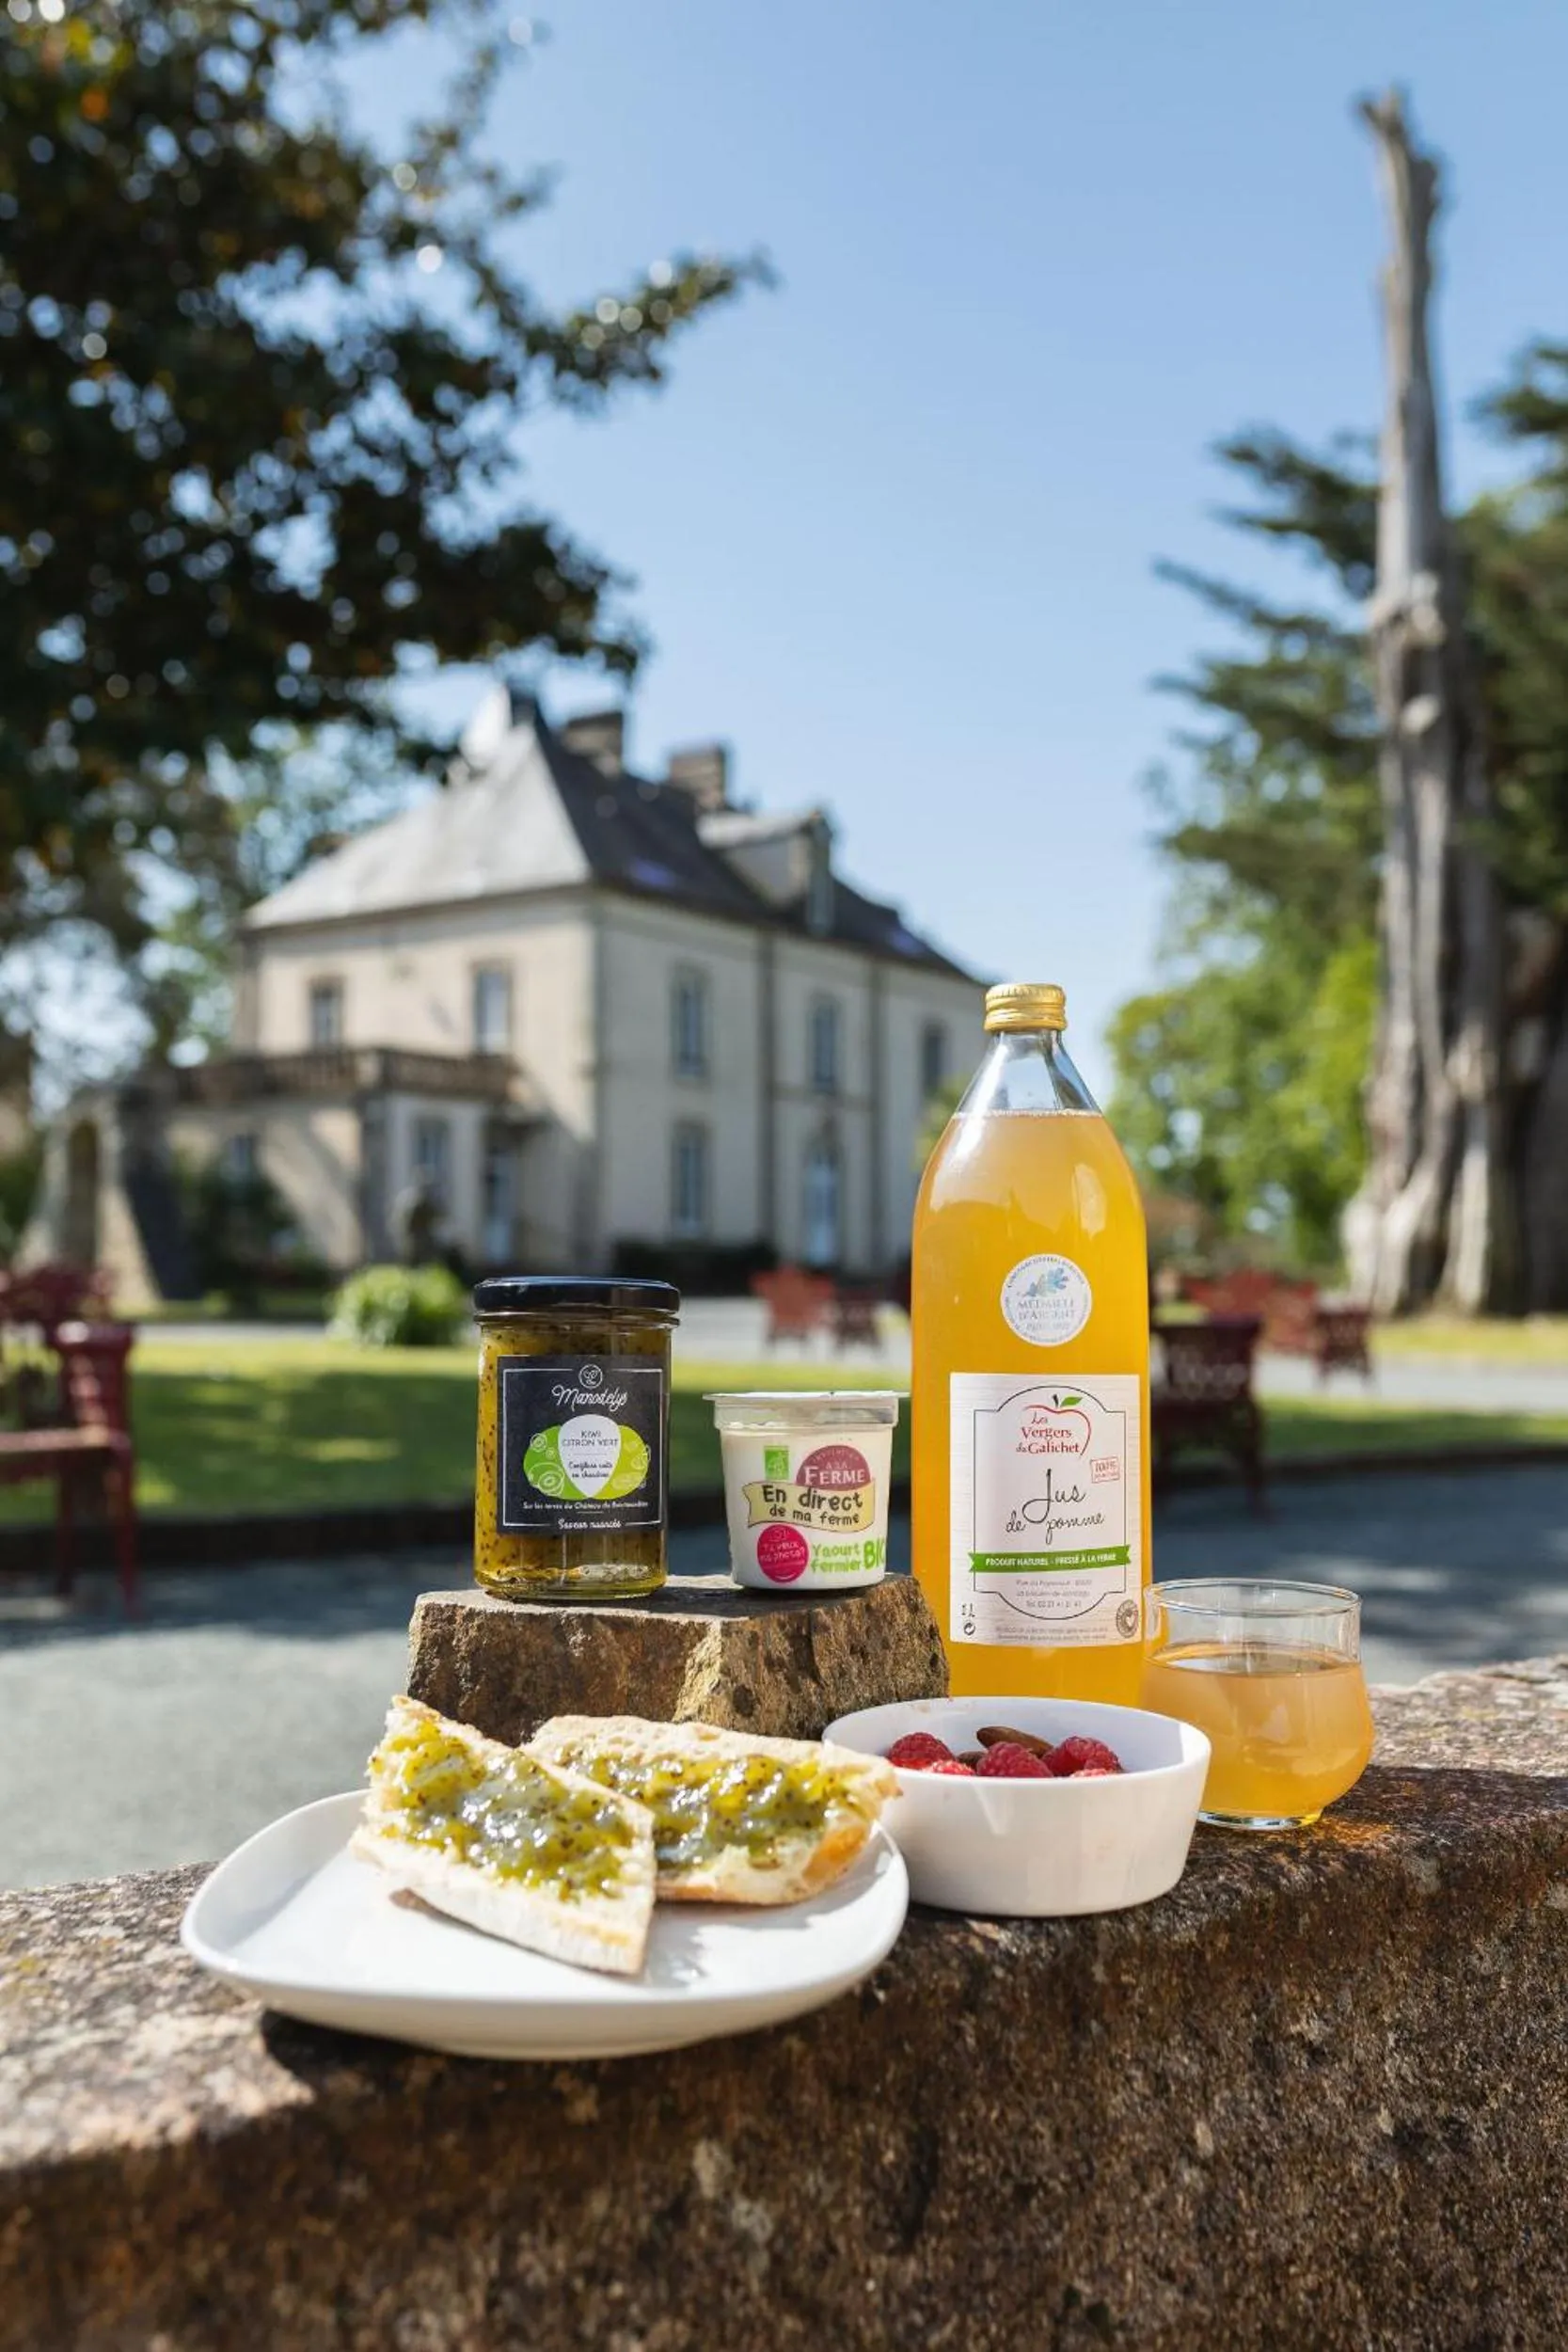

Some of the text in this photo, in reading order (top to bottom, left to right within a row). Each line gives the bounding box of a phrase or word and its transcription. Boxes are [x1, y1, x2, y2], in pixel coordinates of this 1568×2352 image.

[1021, 1426, 1072, 1441] Vergers
[562, 1438, 619, 1447] CITRON VERT
[1027, 1440, 1081, 1455] Galichet
[802, 1465, 866, 1486] FERME
[763, 1485, 863, 1511] En direct
[1022, 1468, 1087, 1524] Jus
[769, 1503, 860, 1526] de ma ferme
[1005, 1510, 1105, 1545] de pomme
[813, 1543, 863, 1558] Yaourt
[811, 1557, 863, 1574] fermier
[986, 1557, 1016, 1566] PRODUIT
[1017, 1558, 1049, 1566] NATUREL
